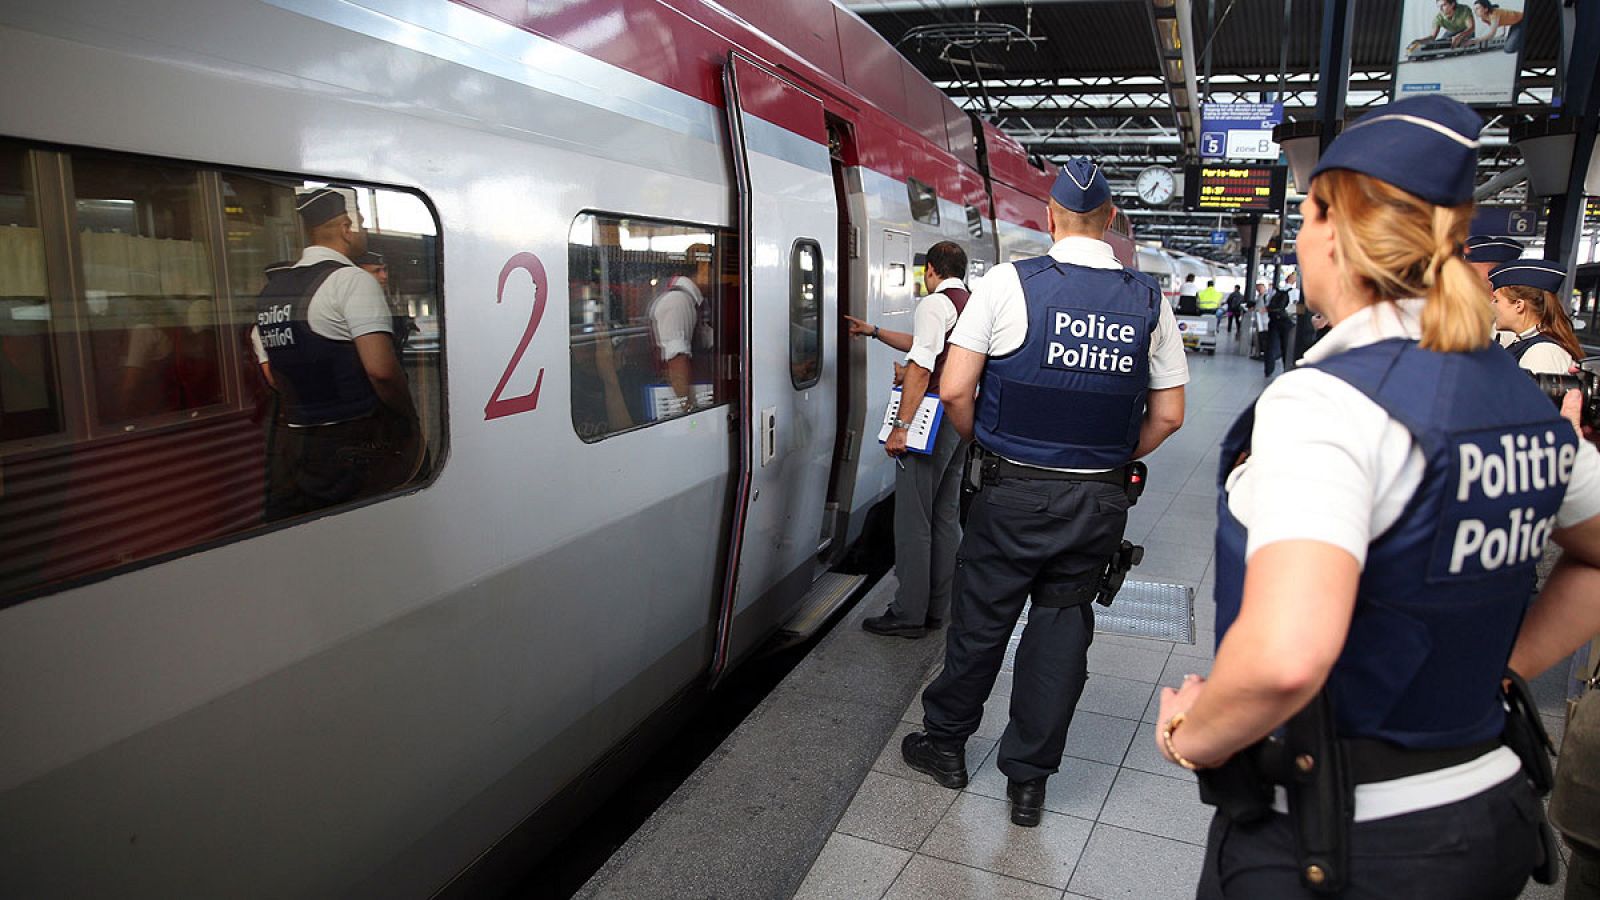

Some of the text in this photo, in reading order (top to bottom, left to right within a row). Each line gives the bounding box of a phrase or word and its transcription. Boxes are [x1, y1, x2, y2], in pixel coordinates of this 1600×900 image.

[1208, 139, 1219, 153] 5
[1259, 139, 1269, 153] B
[1516, 218, 1528, 232] 6
[484, 251, 548, 421] 2
[1055, 311, 1135, 344] Police
[1047, 341, 1133, 373] Politie
[1456, 430, 1576, 502] Politie
